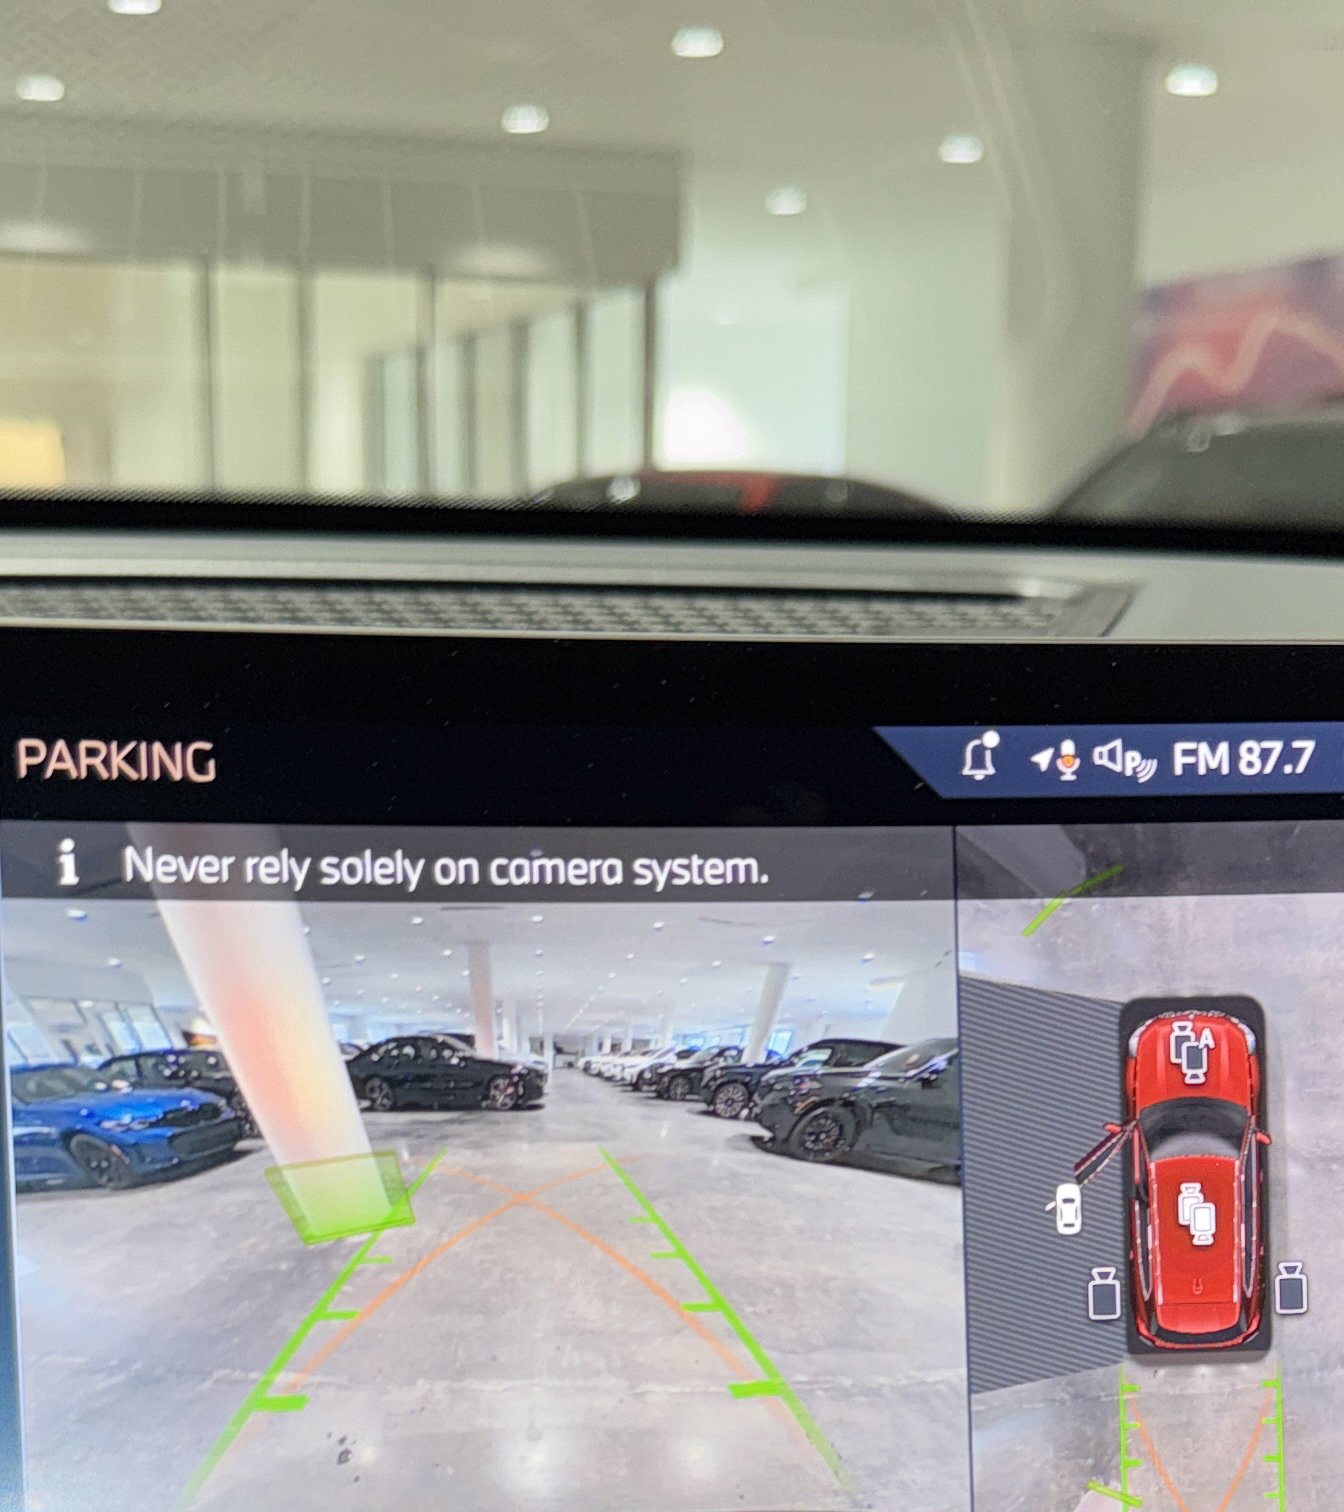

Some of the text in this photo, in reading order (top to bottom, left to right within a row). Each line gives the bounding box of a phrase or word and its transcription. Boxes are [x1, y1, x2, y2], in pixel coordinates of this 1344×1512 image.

[16, 737, 218, 784] PARKING
[1172, 738, 1317, 777] FM 87.7
[123, 844, 770, 893] Never rely solely on camera system.
